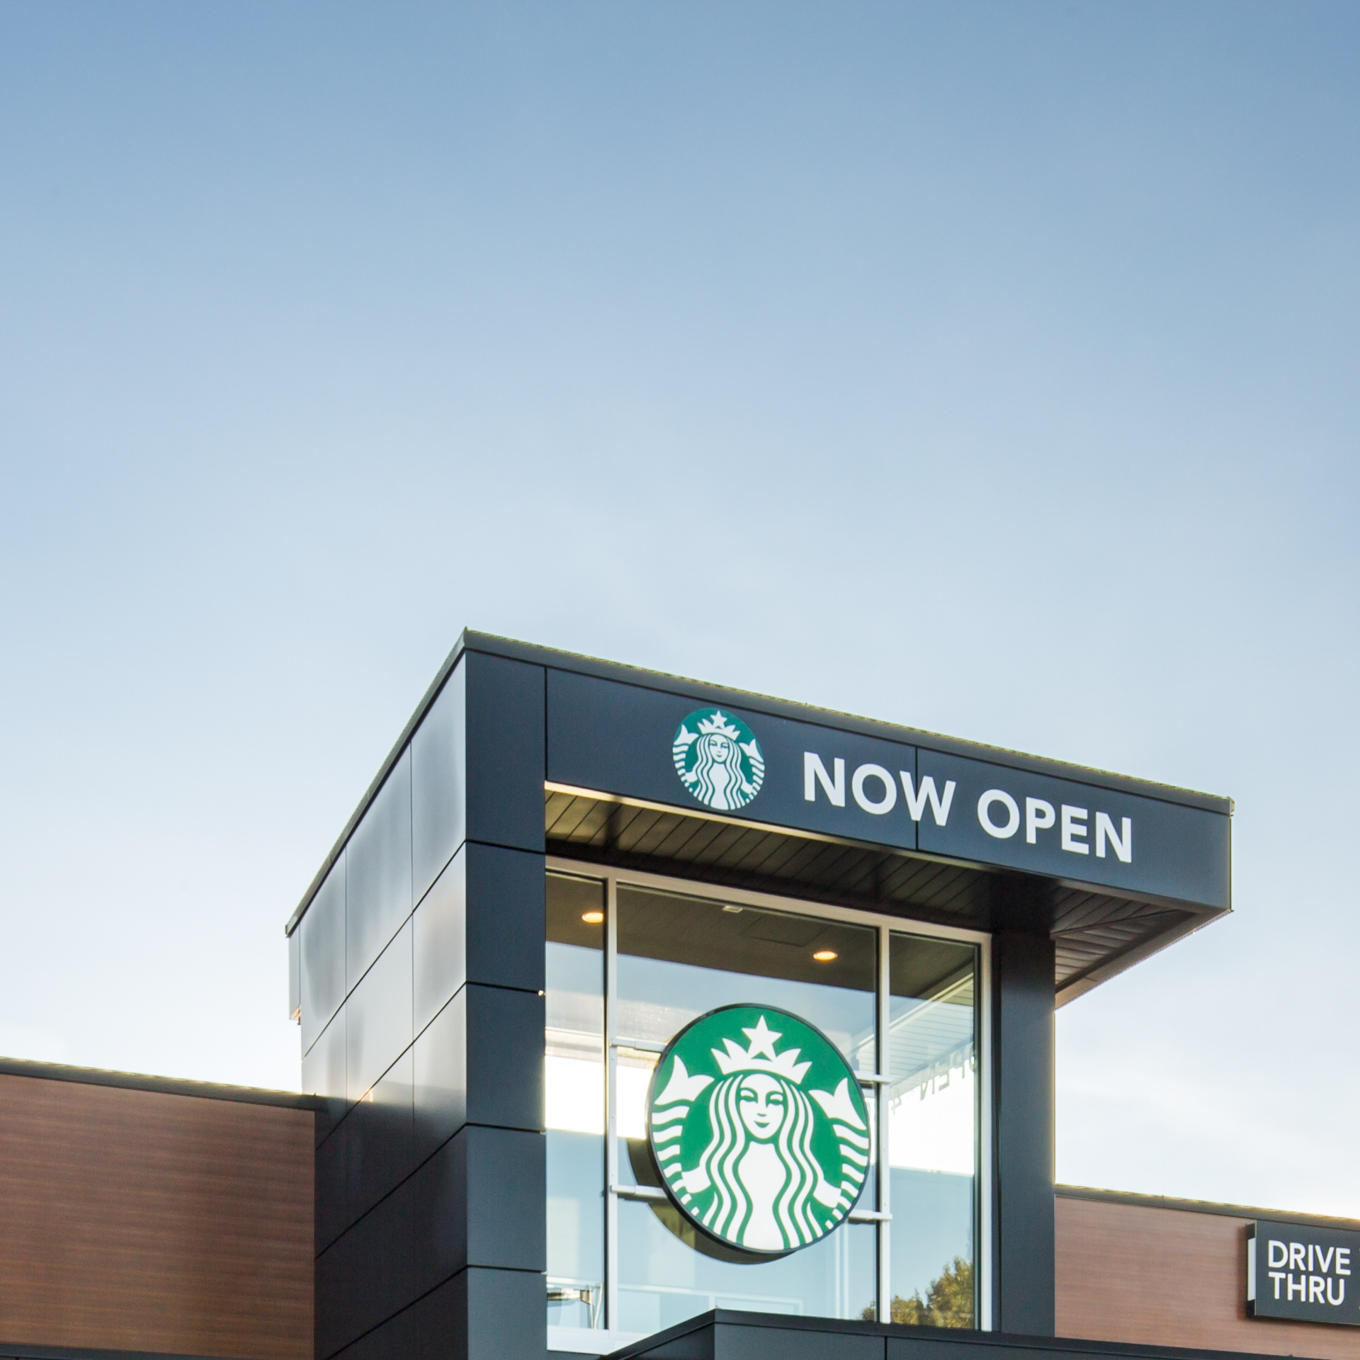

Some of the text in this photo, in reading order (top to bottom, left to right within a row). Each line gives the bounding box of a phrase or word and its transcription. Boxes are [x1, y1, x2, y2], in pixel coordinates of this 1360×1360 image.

[803, 751, 1132, 863] NOW OPEN
[1268, 1240, 1351, 1275] DRIVE
[1268, 1272, 1345, 1306] THRU
